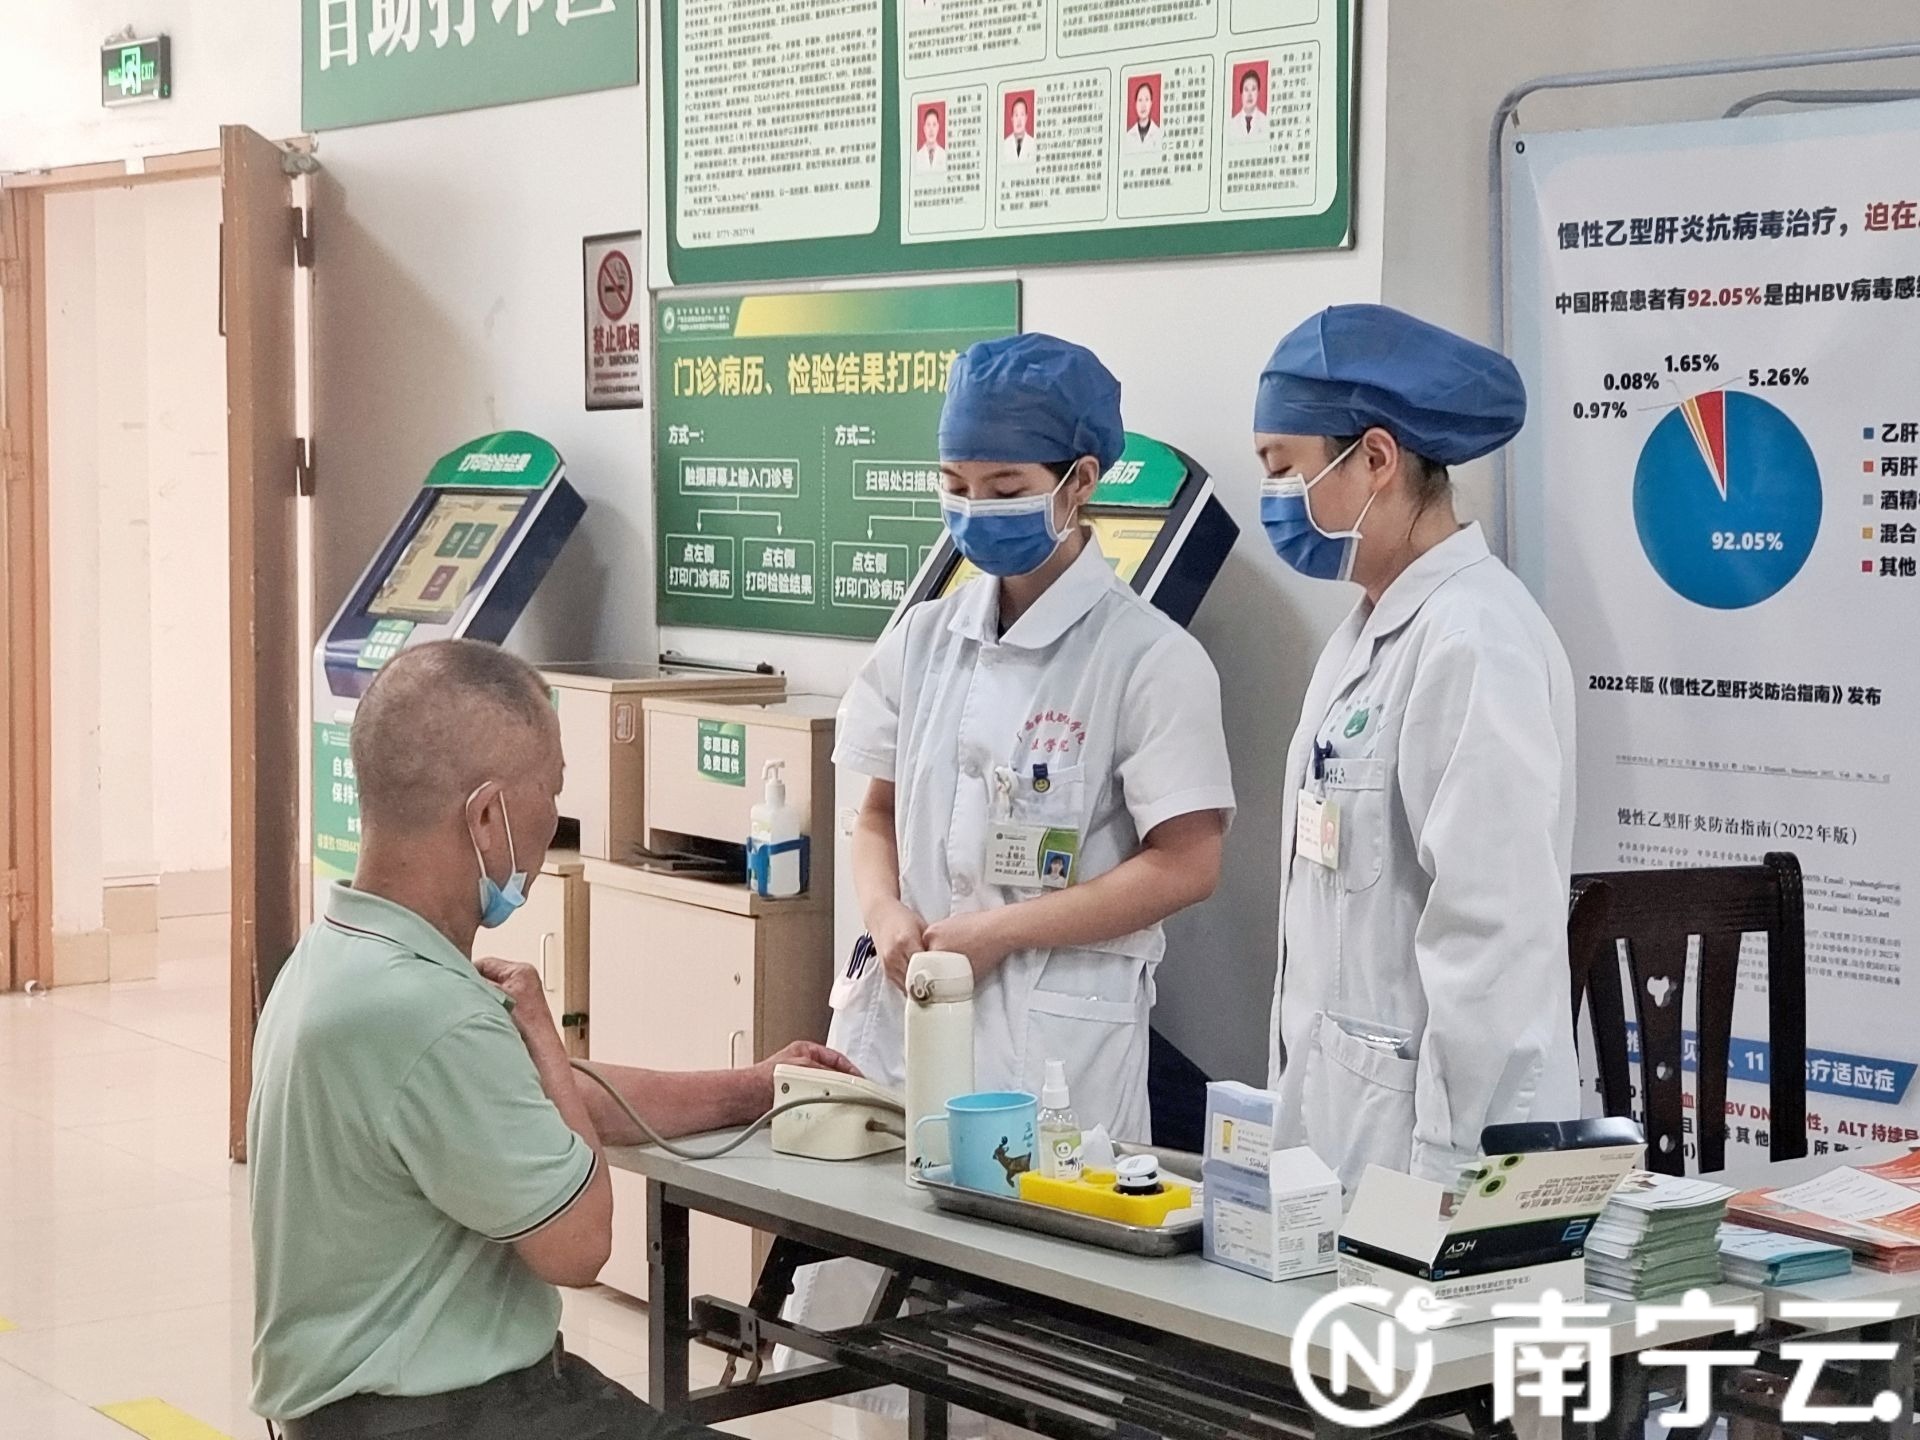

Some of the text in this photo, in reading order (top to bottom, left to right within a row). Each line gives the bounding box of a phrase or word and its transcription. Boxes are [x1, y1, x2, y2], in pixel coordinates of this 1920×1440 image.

[141, 61, 155, 81] EXIT
[1557, 201, 1920, 250] 慢性乙型肝炎抗病毒治疗，迫在
[1554, 274, 1920, 316] 中国肝癌患者有92.05%是由HBV病毒感
[593, 323, 640, 354] 禁止吸烟
[594, 354, 639, 368] NO SMOKING
[1664, 353, 1720, 372] 1.65%
[1603, 372, 1660, 391] 0.08%
[1748, 368, 1810, 387] 5.26%
[1573, 401, 1628, 419] 0.97%
[1880, 423, 1918, 444] 乙肝
[458, 453, 532, 473] 打印检验结果
[1880, 456, 1918, 477] 丙肝
[684, 466, 794, 489] 触摸屏幕上输入门诊号
[865, 470, 942, 492] 扫码处扫描条
[1880, 490, 1920, 511] 酒精
[1711, 531, 1785, 552] 92.05%
[1879, 523, 1917, 543] 混合
[683, 545, 715, 564] 点左侧
[762, 548, 796, 569] 点右侧
[852, 552, 887, 574] 点左侧
[1879, 556, 1917, 577] 其他
[669, 568, 730, 589] 打印门诊病历
[746, 572, 813, 596] 打印检验结果
[834, 577, 905, 602] 打印门诊病历
[1588, 675, 1882, 707] 2022年版《慢性乙型肝炎防治指南》发布
[332, 783, 359, 806] 保持
[1617, 807, 1858, 846] 慢性乙型肝炎防治指南(2022年版)
[1745, 1051, 1764, 1071] 11
[1837, 1120, 1868, 1137] ALT
[1445, 1239, 1477, 1255] HCV
